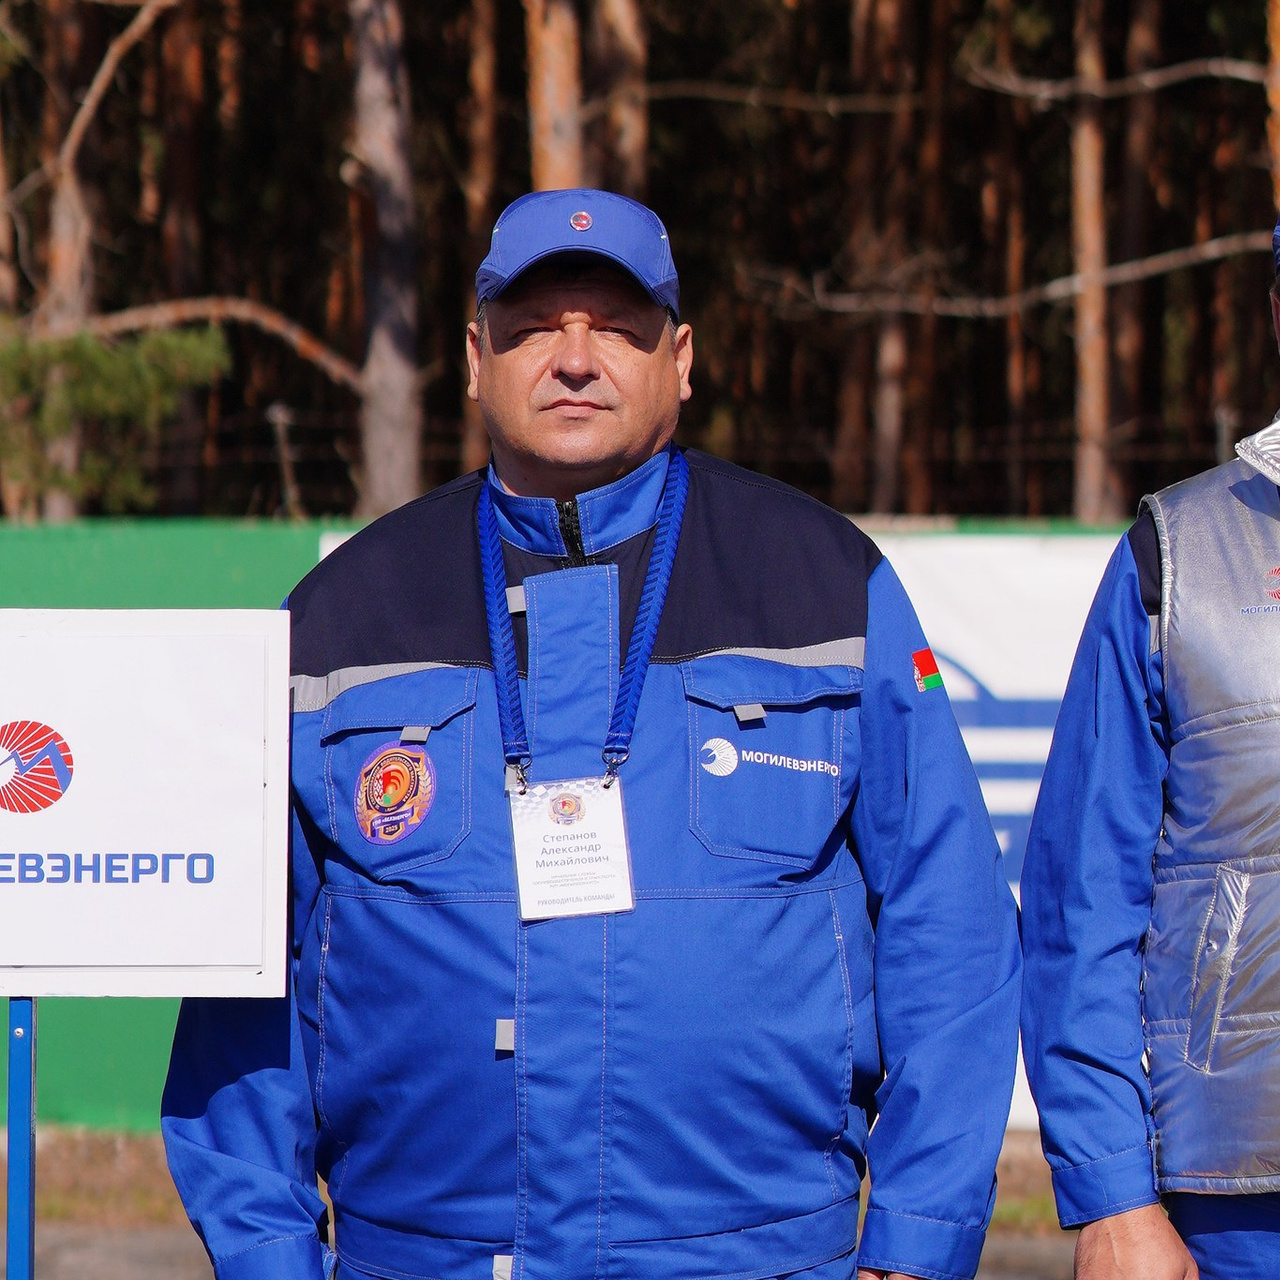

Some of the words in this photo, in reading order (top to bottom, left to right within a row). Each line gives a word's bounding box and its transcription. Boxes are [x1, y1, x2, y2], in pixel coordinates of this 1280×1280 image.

[741, 750, 839, 777] МОГИЛЕВЭНЕРГО
[543, 831, 597, 843] Степанов
[540, 843, 602, 856] Александр
[0, 853, 215, 884] ЕВЭНЕРГО
[535, 856, 609, 869] Михайлович
[584, 893, 615, 903] КОМАНДЫ
